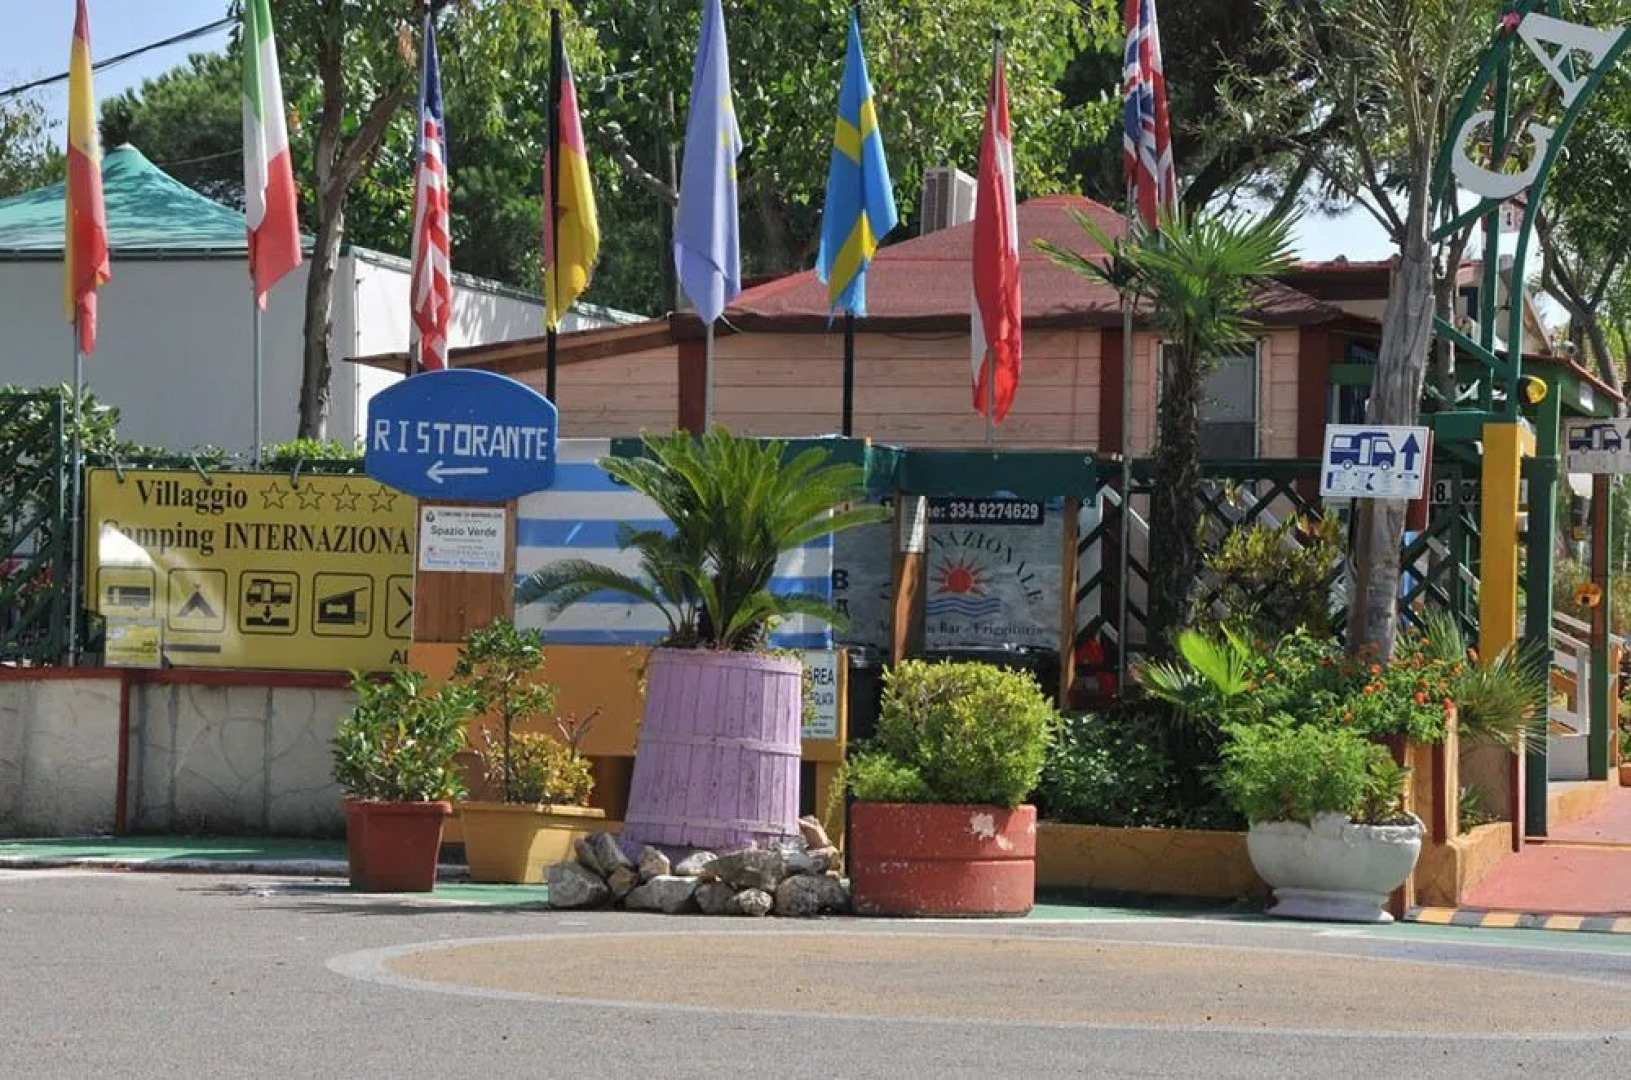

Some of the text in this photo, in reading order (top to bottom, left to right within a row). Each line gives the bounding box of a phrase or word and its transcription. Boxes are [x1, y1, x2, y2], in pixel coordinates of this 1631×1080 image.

[374, 418, 549, 461] RISTORANTE
[135, 479, 248, 515] Villaggio
[950, 502, 1040, 519] 334.9274629
[430, 525, 497, 538] Spazio Verde
